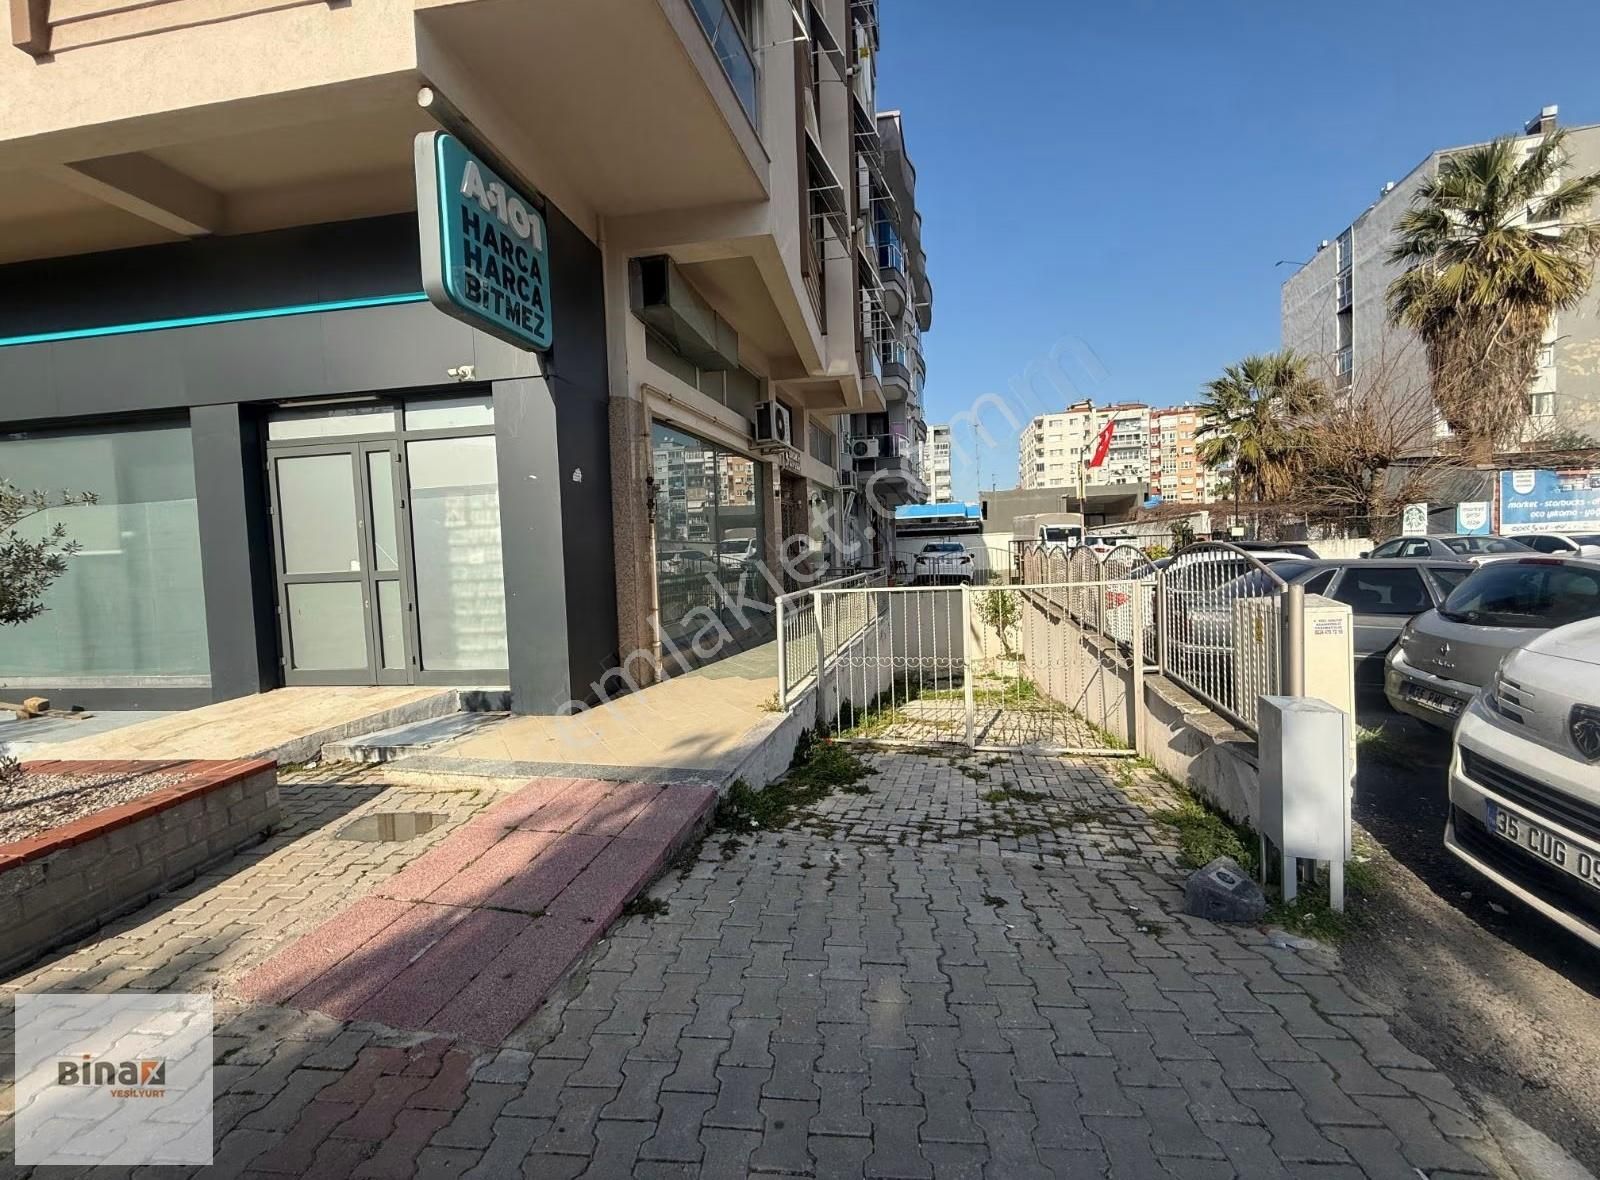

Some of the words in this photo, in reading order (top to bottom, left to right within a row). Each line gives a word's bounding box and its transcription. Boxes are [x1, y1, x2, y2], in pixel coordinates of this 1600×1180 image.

[461, 204, 542, 286] HARCA
[463, 237, 544, 313] HARCA
[1497, 812, 1519, 841] 35
[1528, 827, 1567, 866] CUG
